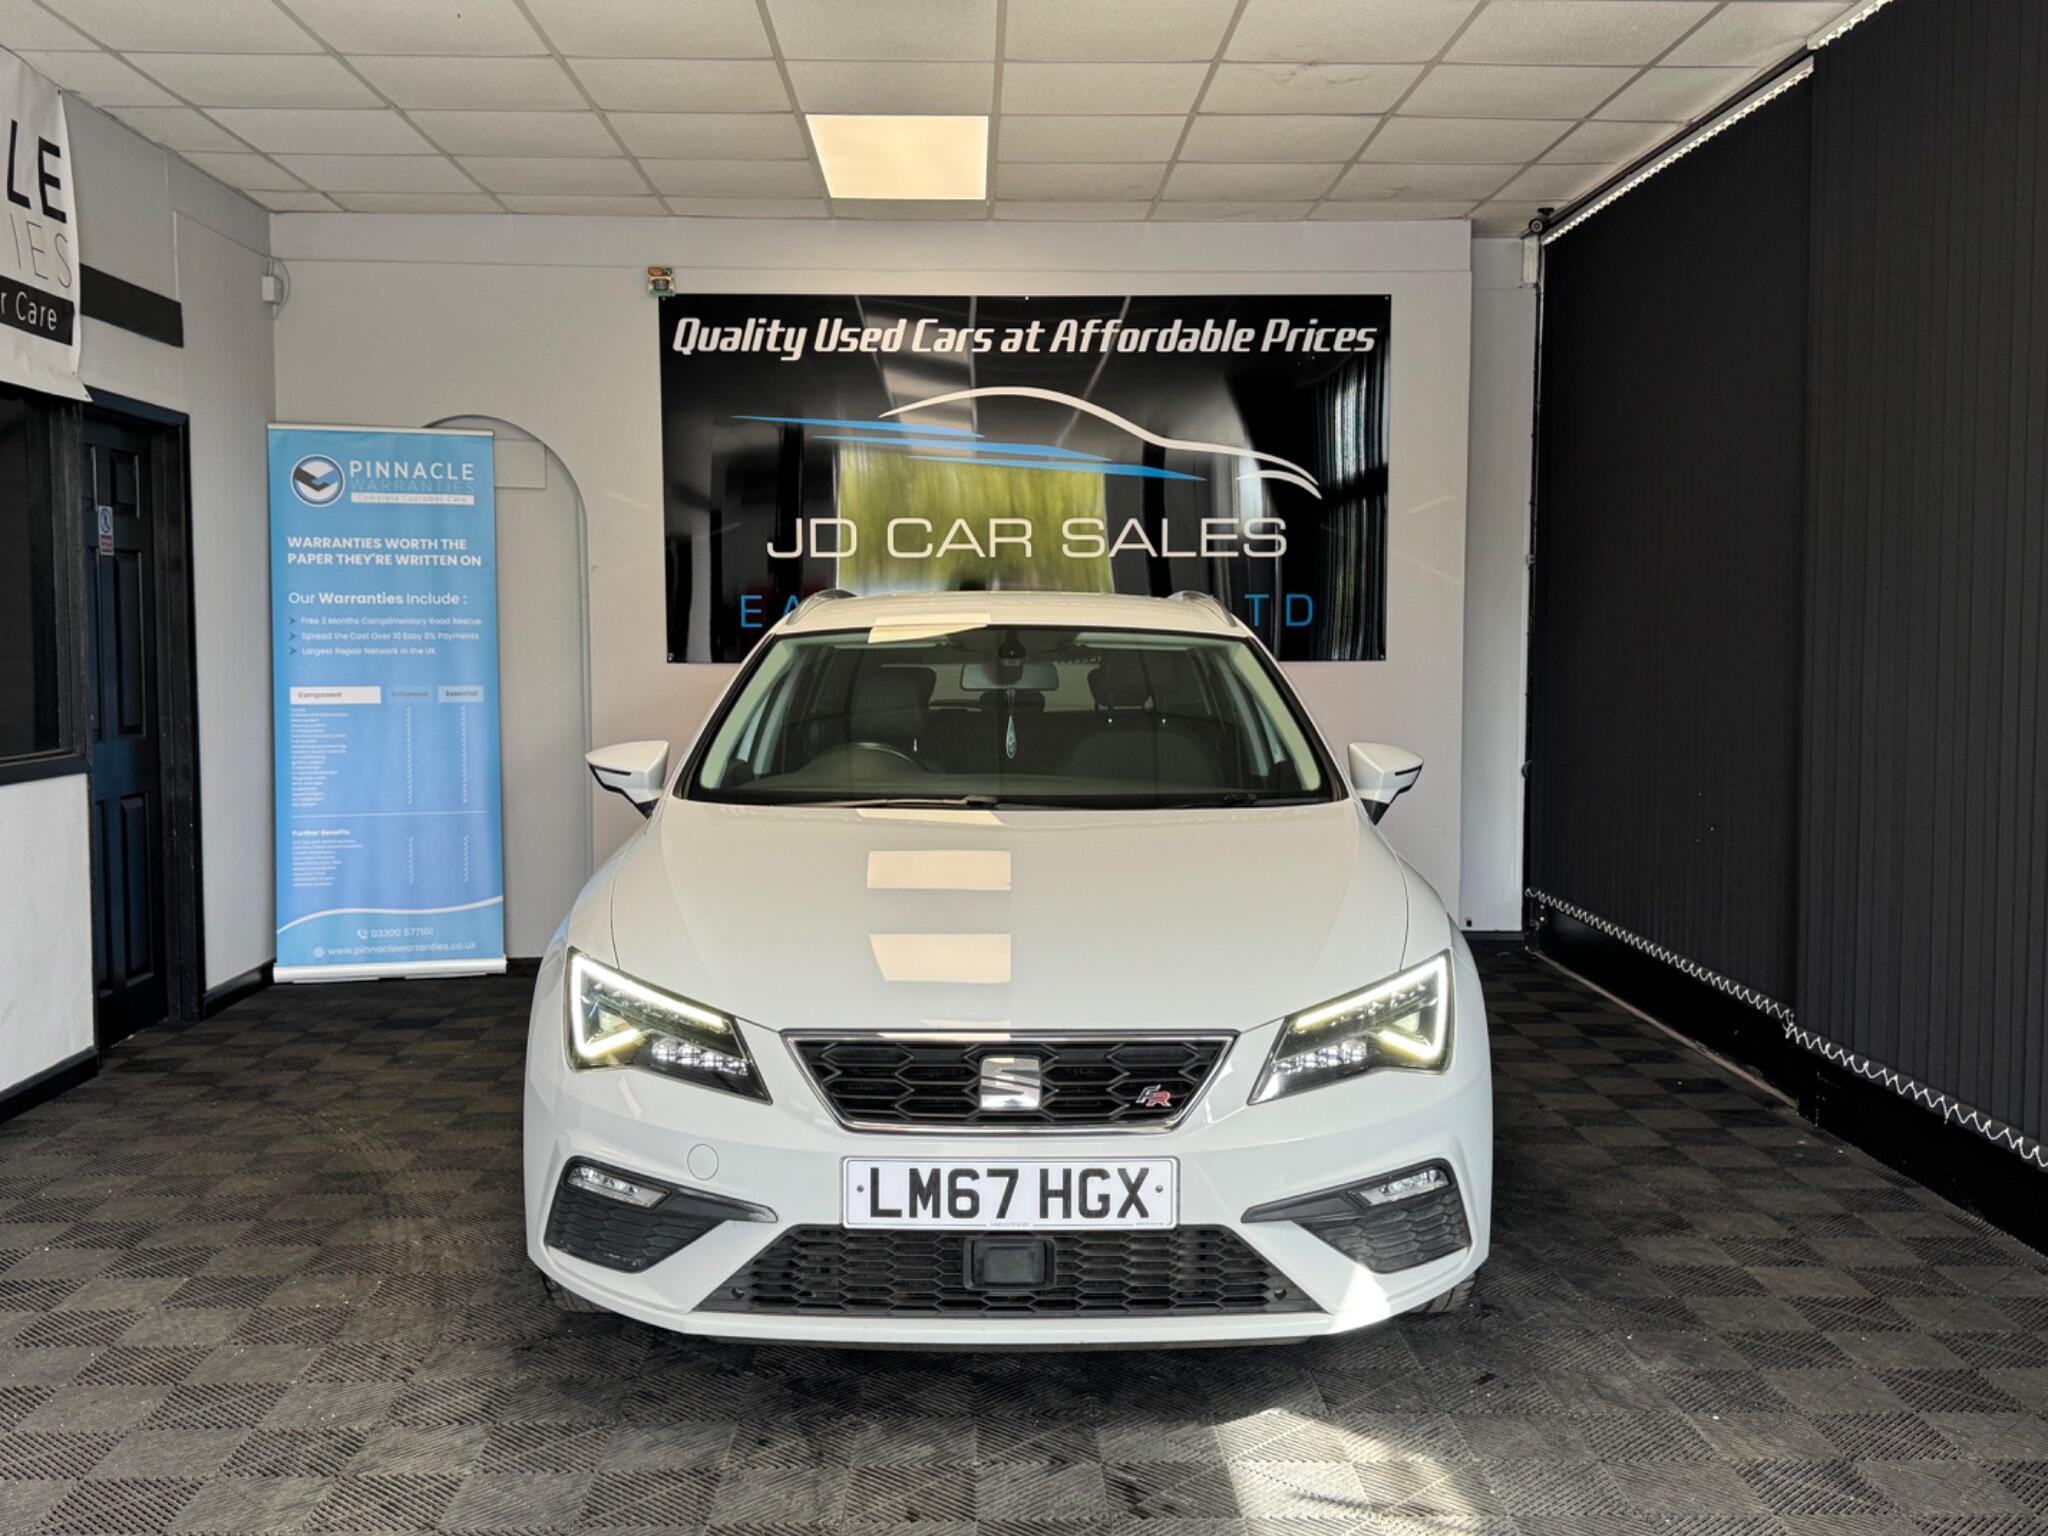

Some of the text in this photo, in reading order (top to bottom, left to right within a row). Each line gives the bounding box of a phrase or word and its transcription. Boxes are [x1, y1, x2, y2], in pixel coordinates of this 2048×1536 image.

[16, 291, 57, 331] Care
[673, 317, 1377, 361] Quality Used Cars at Affordable Prices
[350, 460, 475, 481] PINNACLE
[287, 536, 467, 551] WARRANTIES WORTH THE
[766, 518, 1288, 559] JD CAR SALES
[287, 552, 482, 567] PAPER THEY'RE WRITTEN ON
[288, 592, 315, 605] Our
[318, 591, 404, 605] Warranties
[406, 591, 460, 605] Include
[328, 615, 360, 625] Months
[301, 631, 333, 642] Spread
[350, 631, 370, 640] Cost
[370, 631, 391, 640] Over
[437, 631, 479, 642] Payments
[301, 647, 333, 657] Largest
[335, 647, 362, 657] Repair
[364, 647, 398, 656] Network
[869, 1167, 1150, 1219] LM67 HGX
